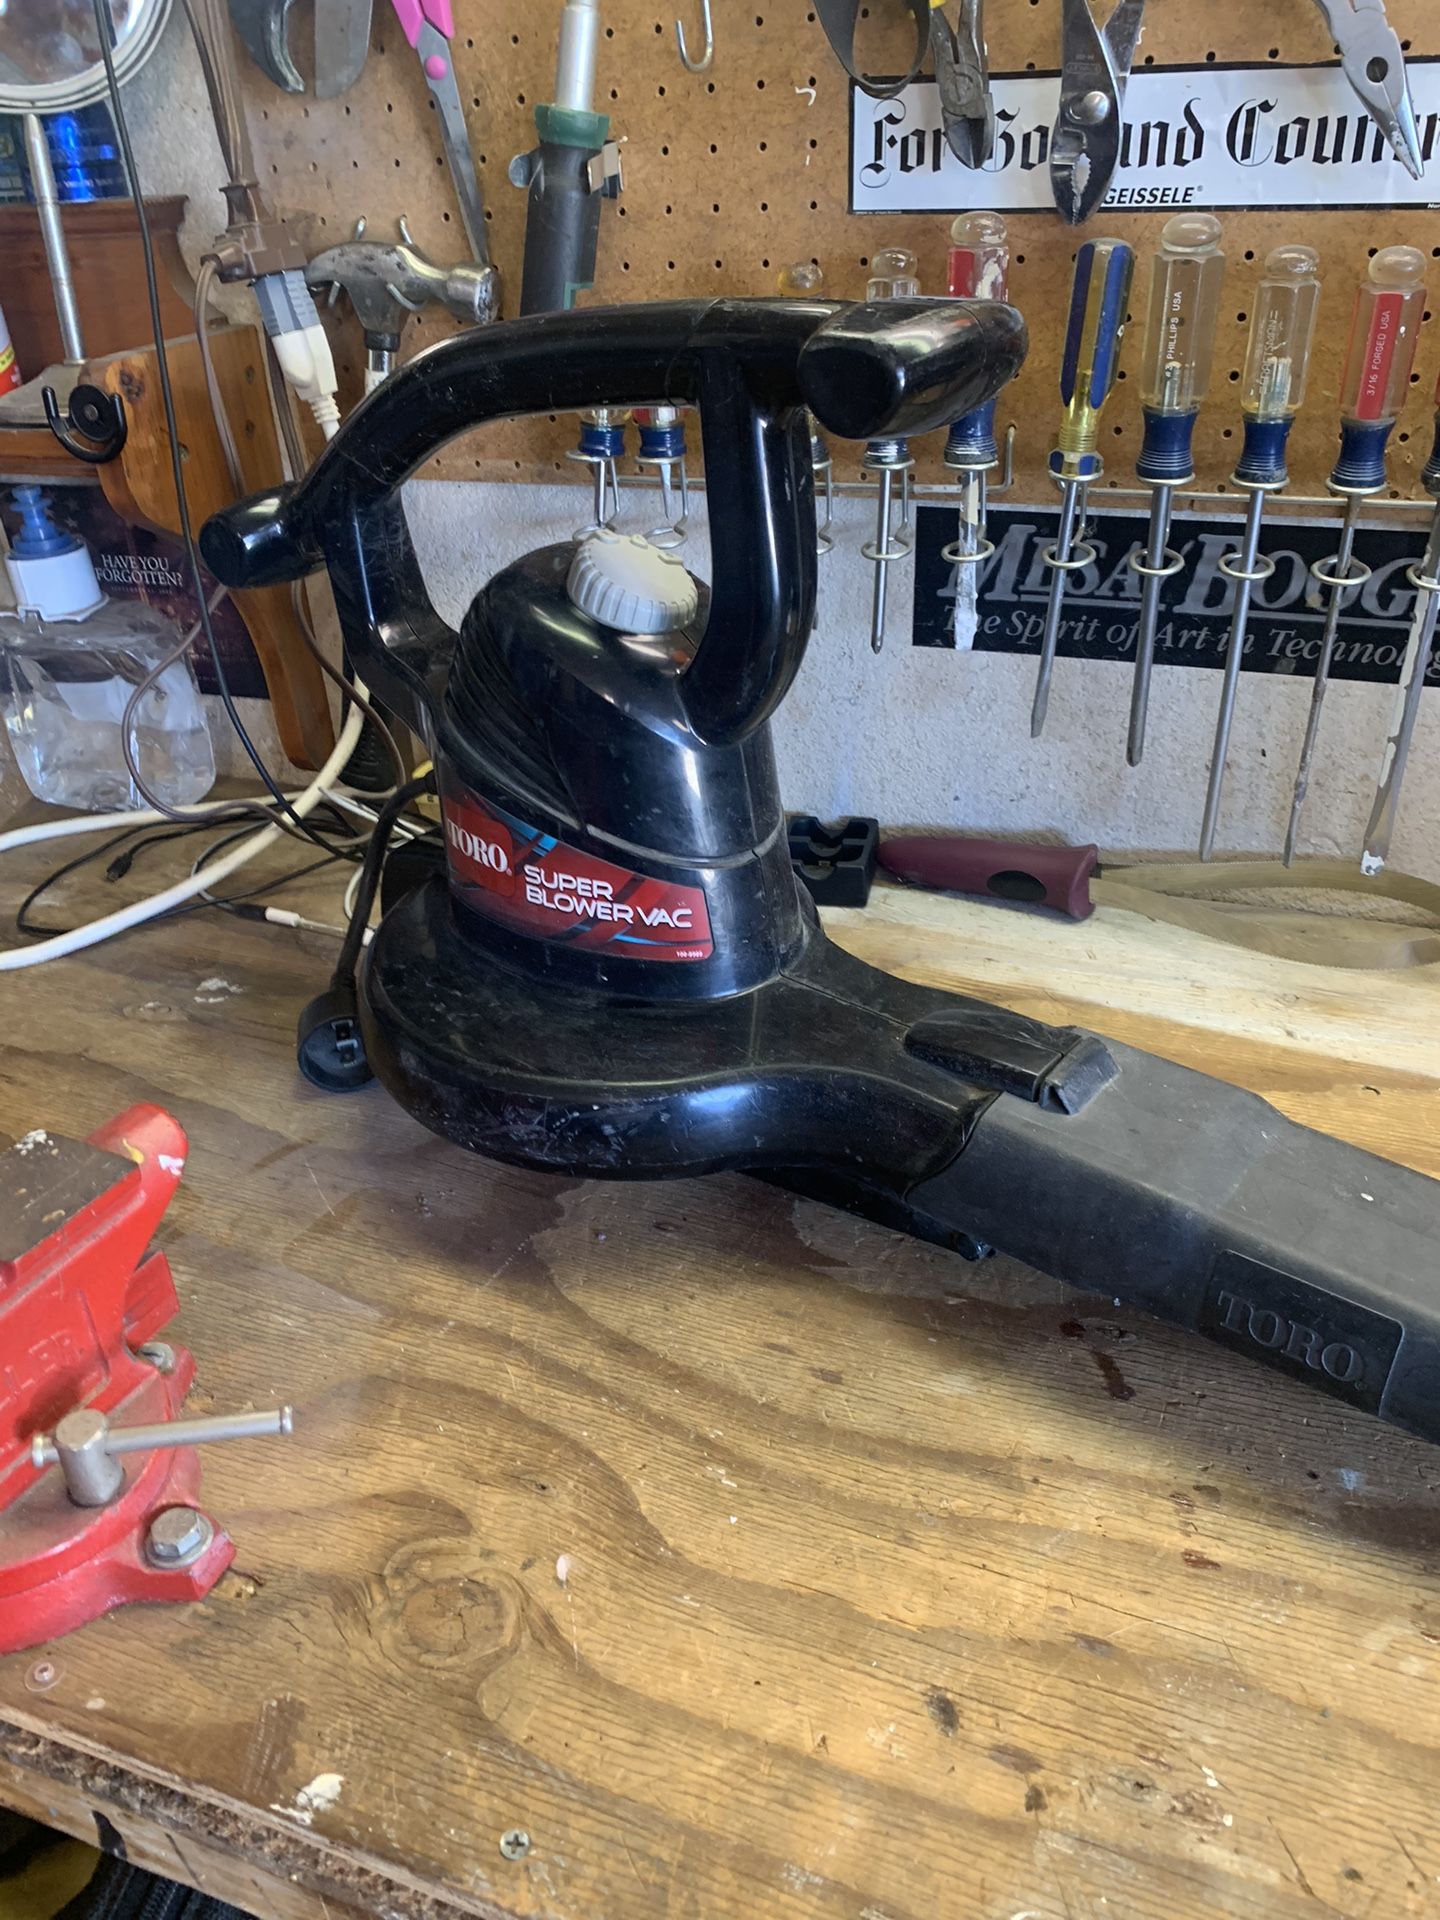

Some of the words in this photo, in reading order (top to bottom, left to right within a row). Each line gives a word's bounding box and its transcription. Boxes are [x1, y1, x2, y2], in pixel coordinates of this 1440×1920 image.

[859, 98, 951, 188] For
[1172, 291, 1183, 311] USA
[1166, 317, 1179, 360] PHILLIPS
[1380, 310, 1391, 330] USA
[1371, 333, 1387, 370] FORGED
[1366, 373, 1379, 396] 3/16
[95, 567, 183, 587] FORGOTTEN?
[101, 554, 138, 570] HAVE
[138, 556, 169, 571] YOU
[944, 605, 1001, 635] Te
[1006, 609, 1101, 645] Sprit
[1106, 618, 1141, 652] of
[1152, 621, 1211, 650] Art
[1266, 628, 1440, 678] Technog
[447, 818, 509, 873] TORO
[523, 864, 614, 901] SUPER
[526, 884, 634, 925] BLOWER
[636, 906, 693, 929] VAC
[1218, 1290, 1364, 1382] TORO
